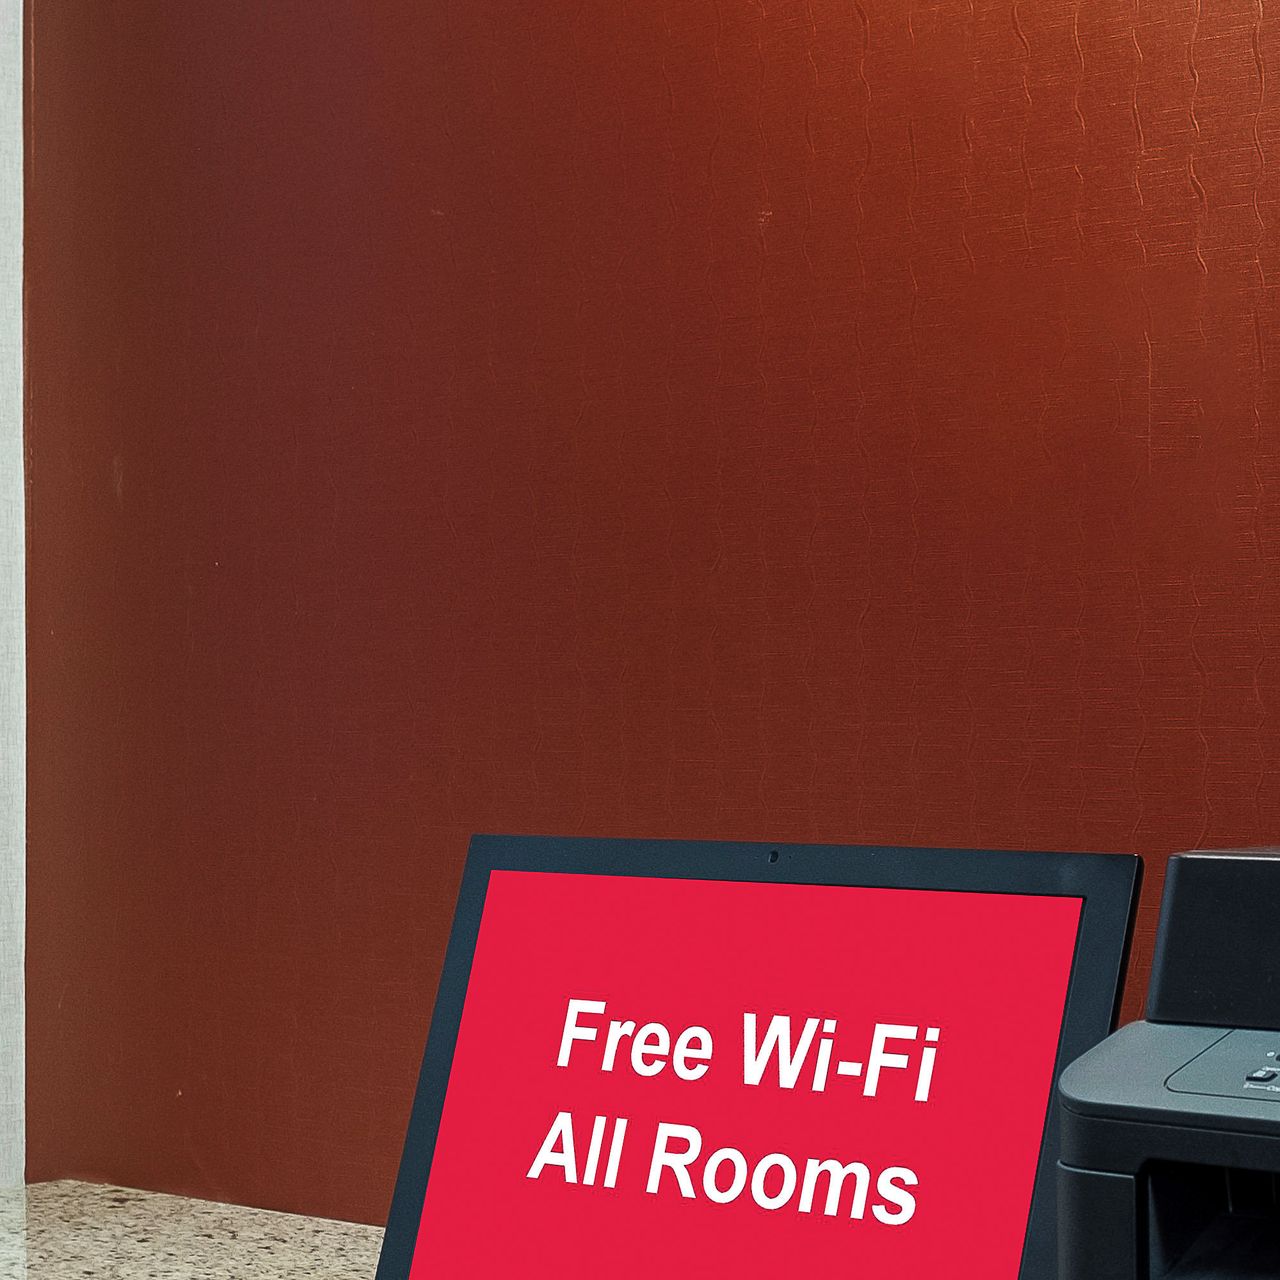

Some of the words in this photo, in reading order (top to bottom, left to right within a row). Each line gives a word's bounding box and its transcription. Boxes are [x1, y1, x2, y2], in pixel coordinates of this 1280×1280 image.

[557, 999, 713, 1081] Free
[743, 1012, 941, 1102] Wi-Fi
[526, 1111, 628, 1189] All
[645, 1122, 919, 1226] Rooms
